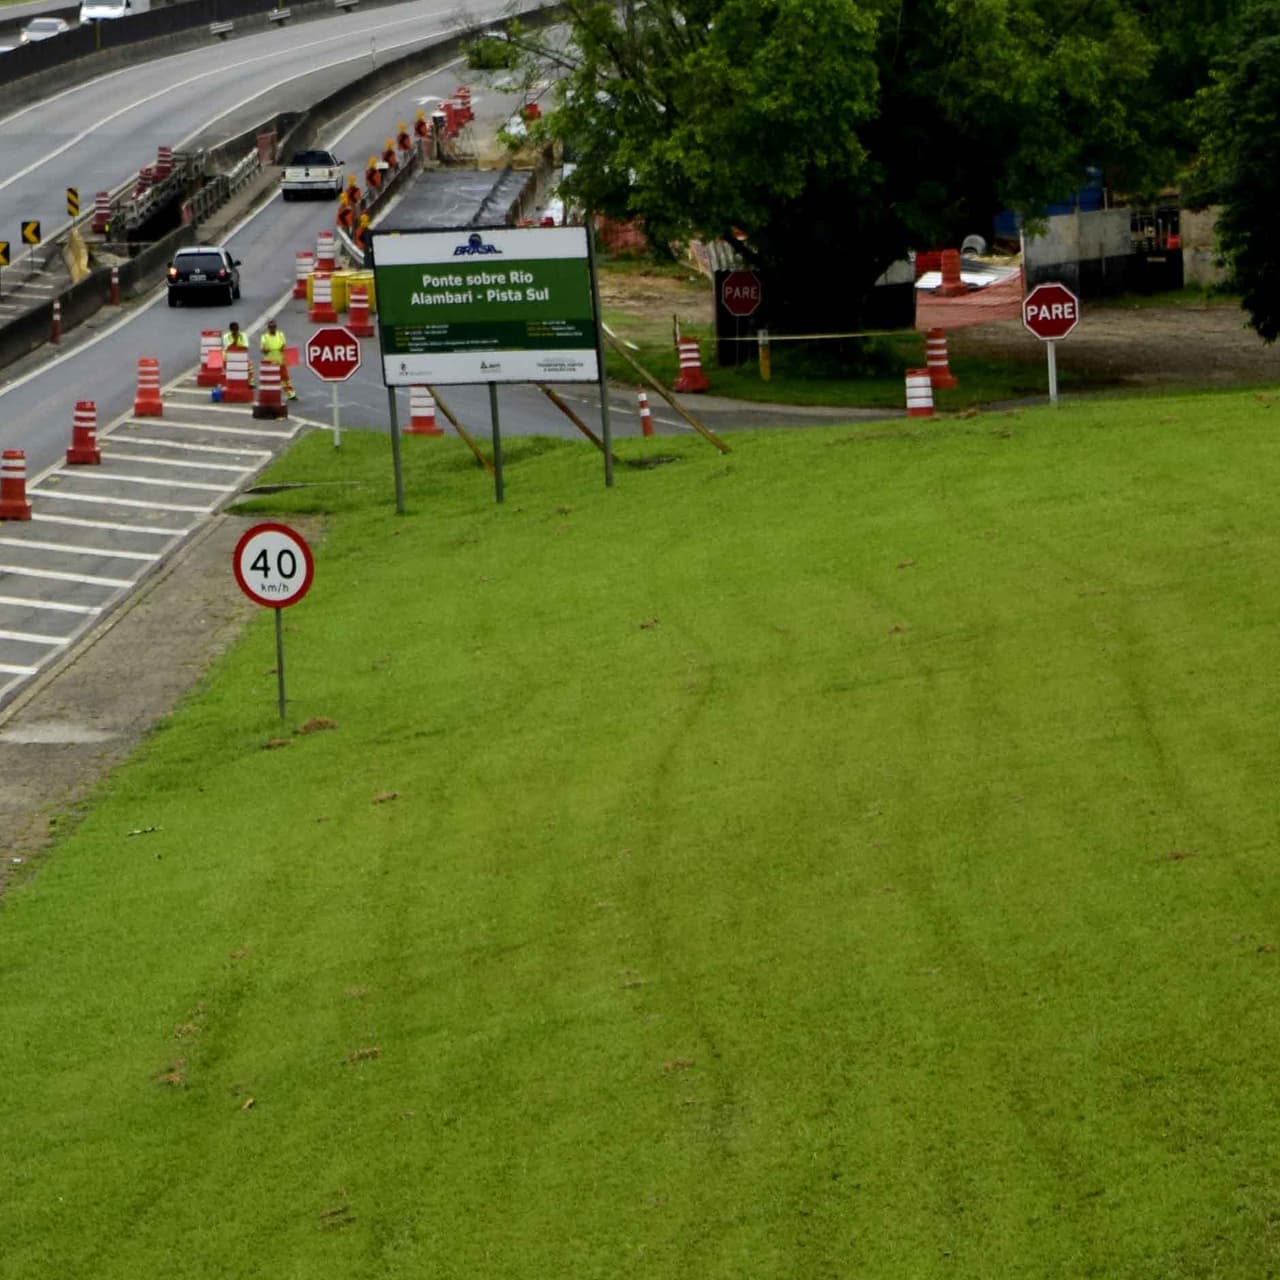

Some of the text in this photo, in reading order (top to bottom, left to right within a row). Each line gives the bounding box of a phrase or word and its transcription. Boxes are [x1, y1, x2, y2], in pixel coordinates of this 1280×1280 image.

[453, 244, 503, 256] BRASIL
[422, 270, 534, 288] Ponte sobre Rio
[411, 290, 473, 306] Alambari
[486, 288, 523, 302] Pista
[526, 287, 550, 301] Sul
[725, 286, 759, 300] PARE
[1026, 302, 1075, 322] PARE
[309, 345, 357, 362] PARE
[249, 548, 297, 579] 40
[261, 583, 289, 593] km/h
